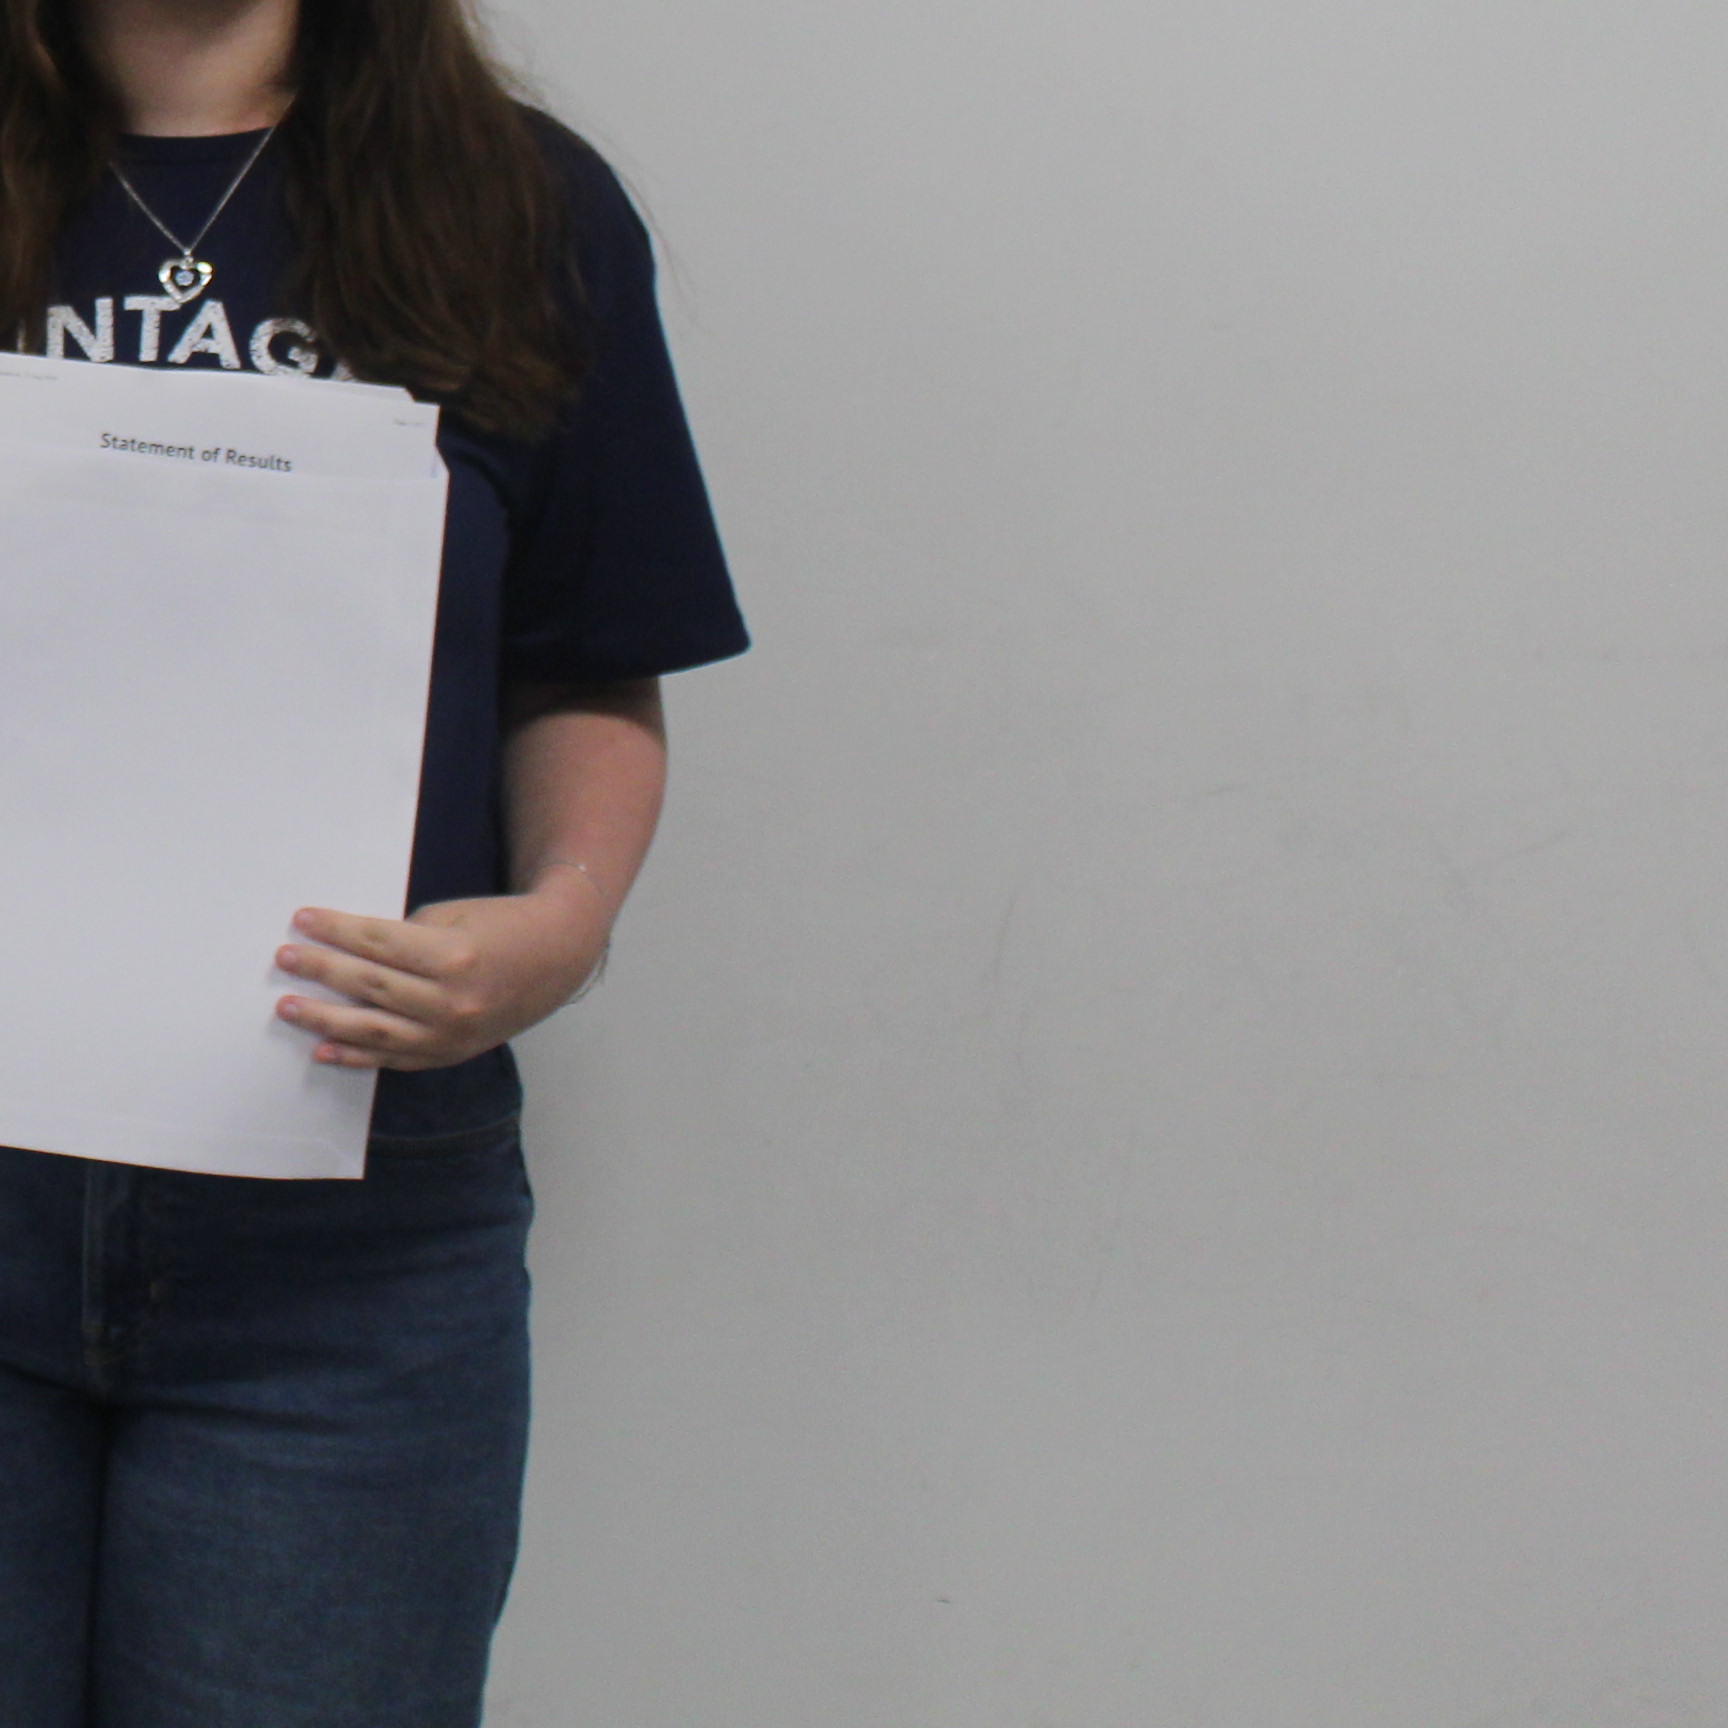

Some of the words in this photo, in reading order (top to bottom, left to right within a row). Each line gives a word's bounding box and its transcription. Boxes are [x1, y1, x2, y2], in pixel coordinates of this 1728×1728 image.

[100, 432, 195, 460] Statement
[201, 447, 220, 462] of
[225, 449, 293, 472] Results
